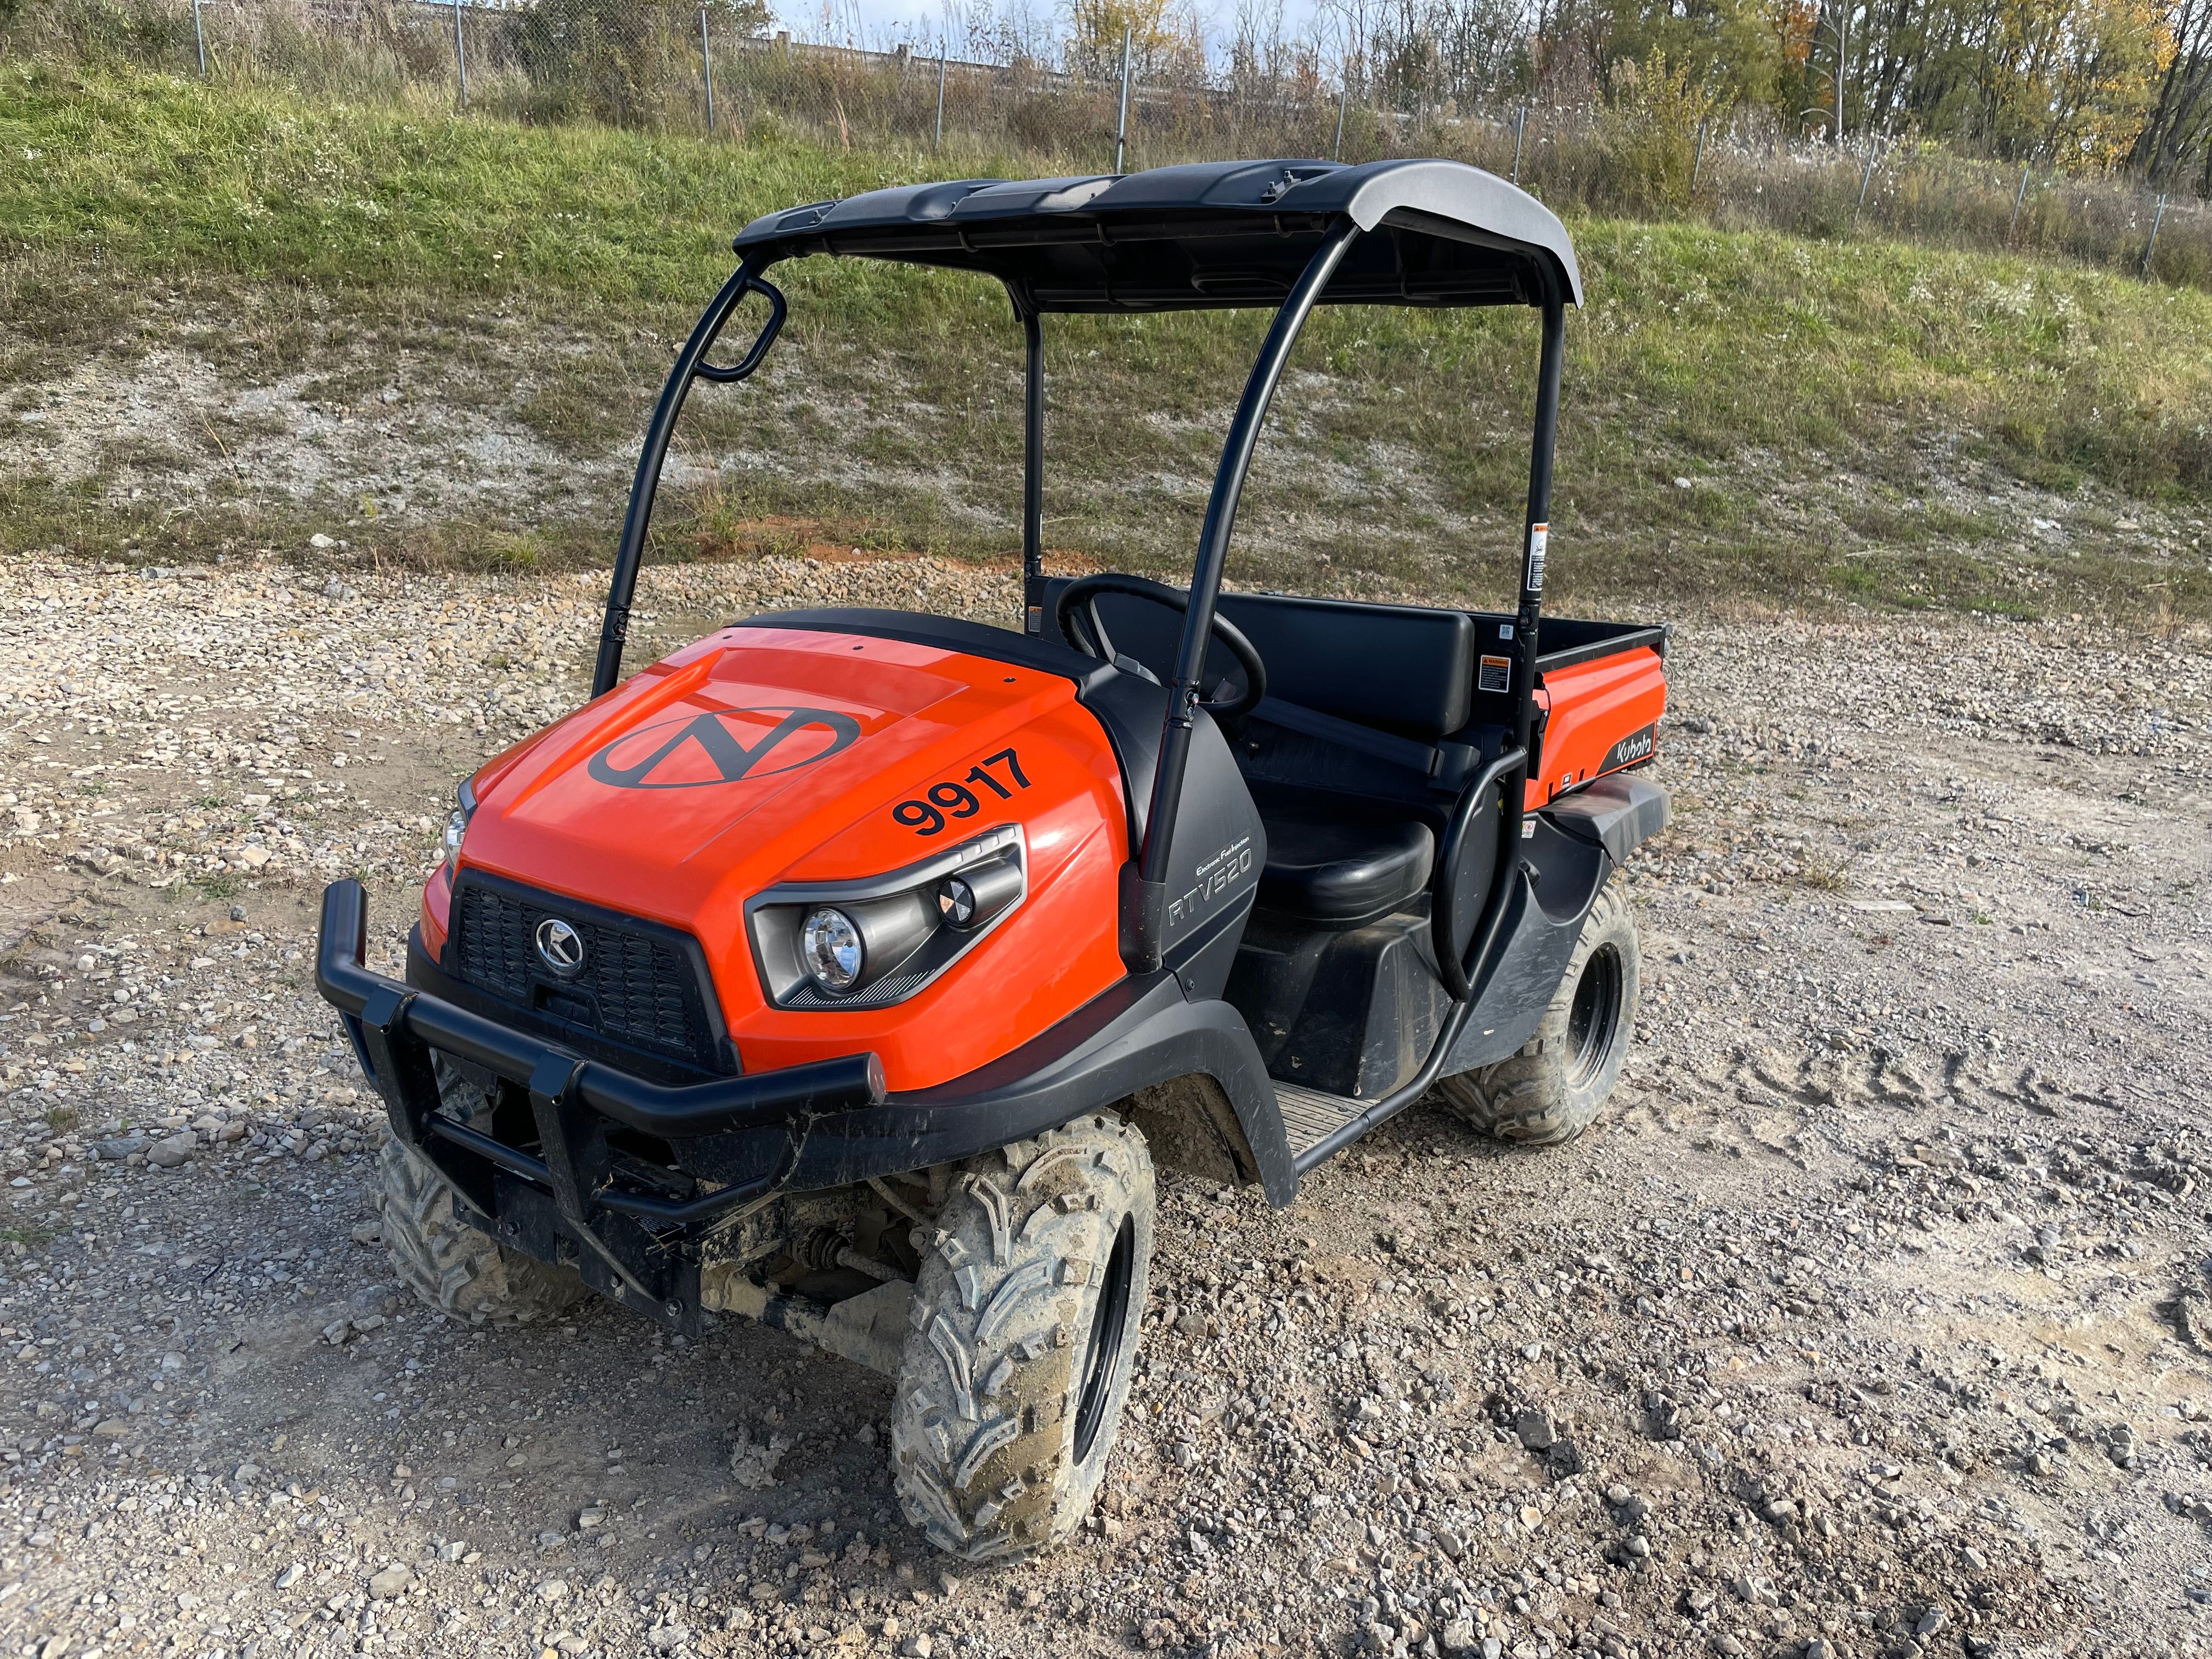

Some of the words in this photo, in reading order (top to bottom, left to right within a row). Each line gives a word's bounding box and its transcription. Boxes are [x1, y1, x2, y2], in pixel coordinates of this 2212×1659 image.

[1617, 734, 1651, 763] Kubota
[893, 748, 1031, 836] 9917
[1197, 857, 1220, 876] Electronic
[1221, 848, 1231, 860] Fuel
[1231, 837, 1249, 852] Injection
[1169, 848, 1251, 926] RTV520
